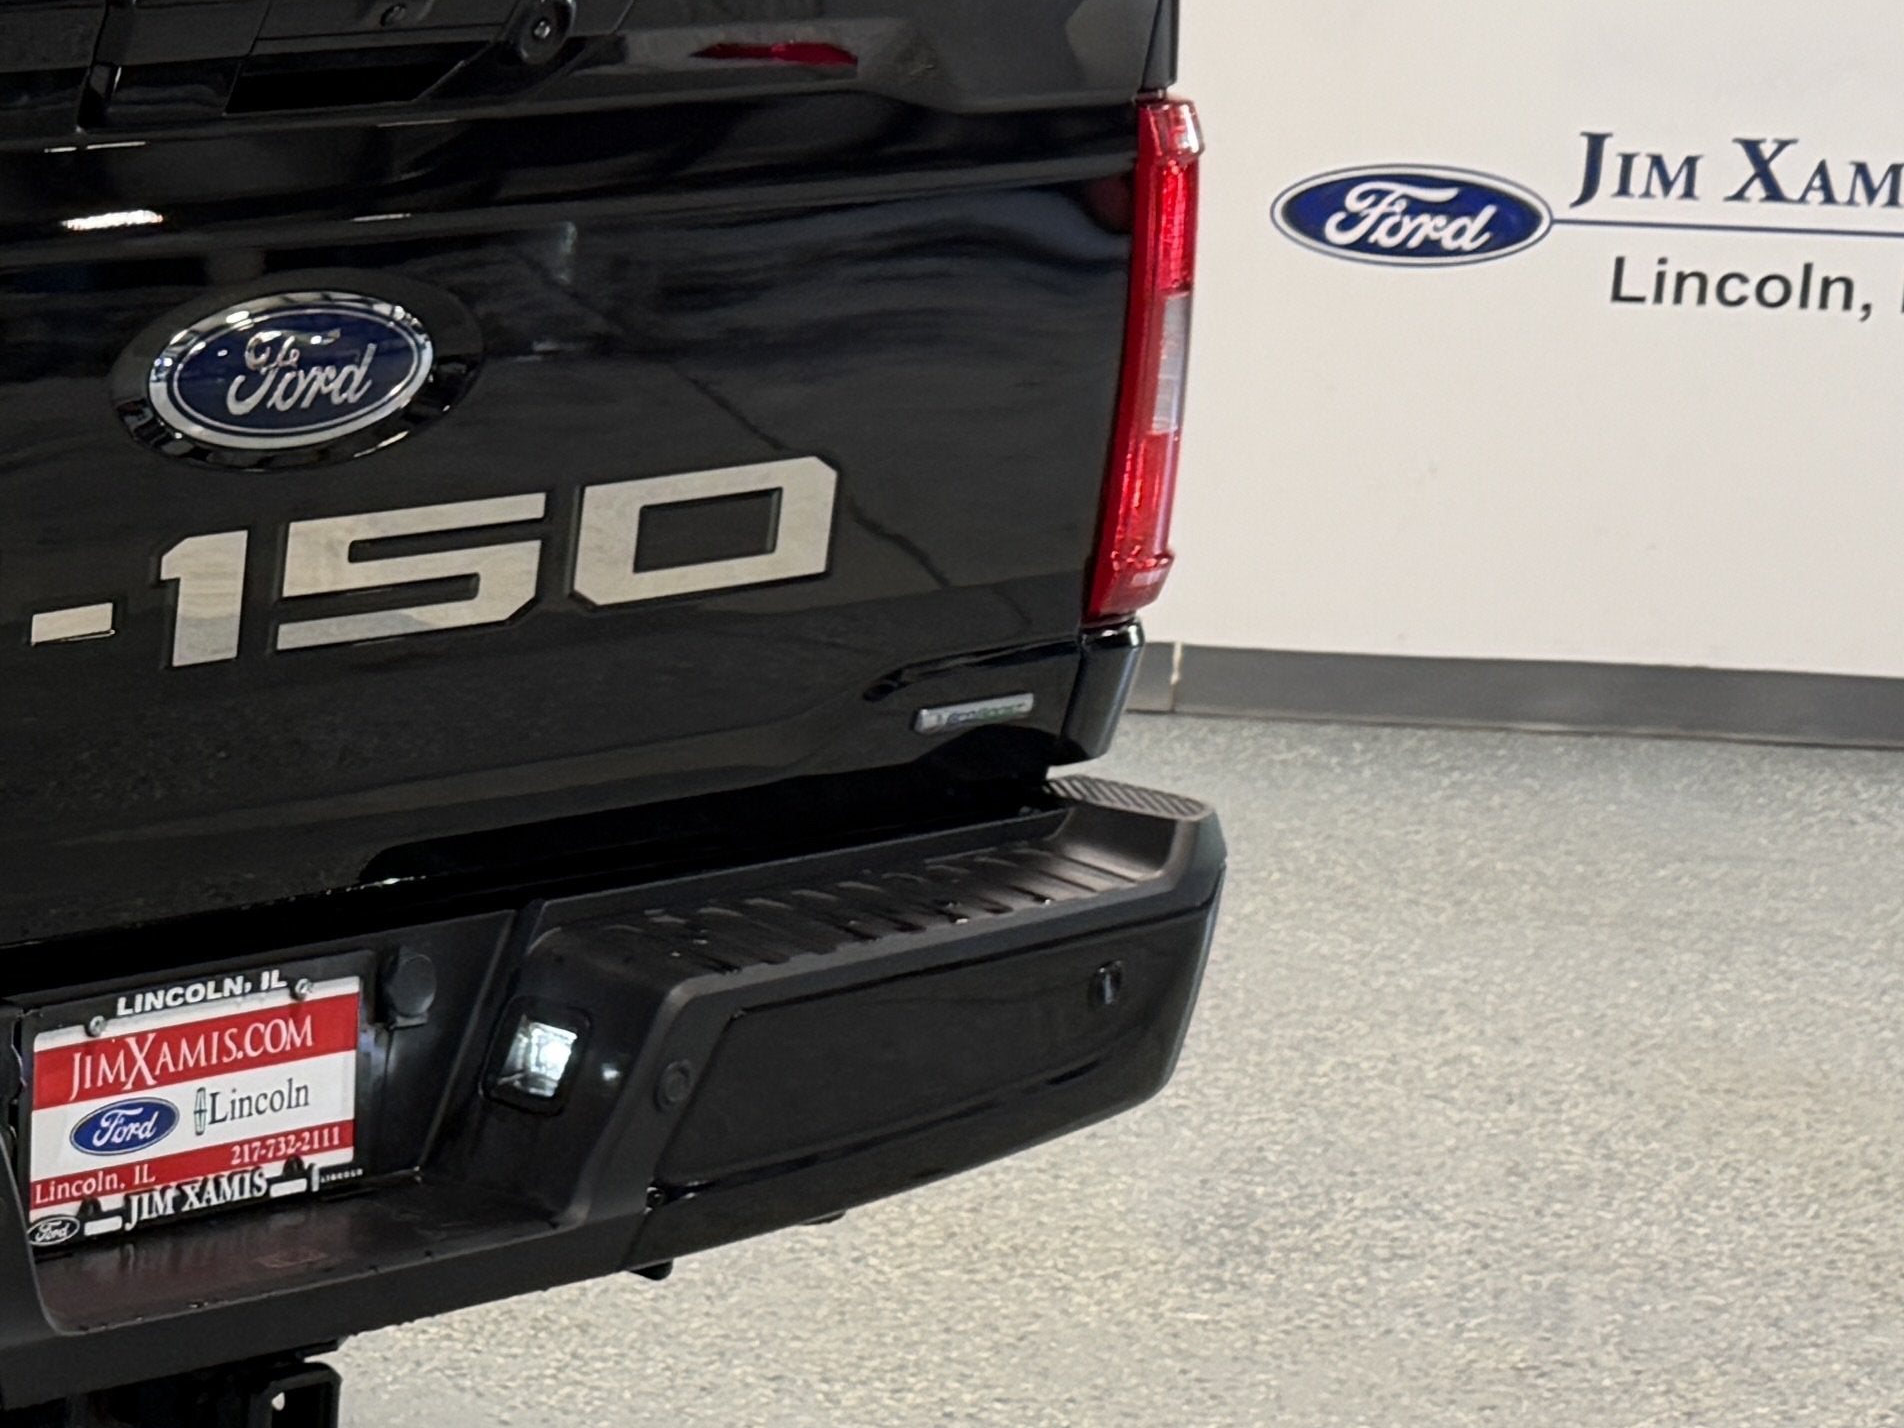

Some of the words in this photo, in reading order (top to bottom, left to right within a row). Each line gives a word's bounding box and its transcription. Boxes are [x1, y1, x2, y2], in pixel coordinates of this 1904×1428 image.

[1569, 131, 1704, 209] JIM
[1323, 180, 1497, 252] Ford
[1610, 255, 1874, 323] Lincoln,
[225, 328, 378, 416] Ford
[116, 974, 252, 1018] LINCOLN,
[259, 970, 288, 991] IL
[208, 1078, 311, 1125] Lincoln
[92, 1108, 158, 1148] Ford
[230, 1126, 341, 1165] 217-732-2111
[133, 1163, 156, 1185] IL
[124, 1186, 178, 1231] JIM
[181, 1167, 268, 1212] XAMIS
[34, 1220, 70, 1243] Ford
